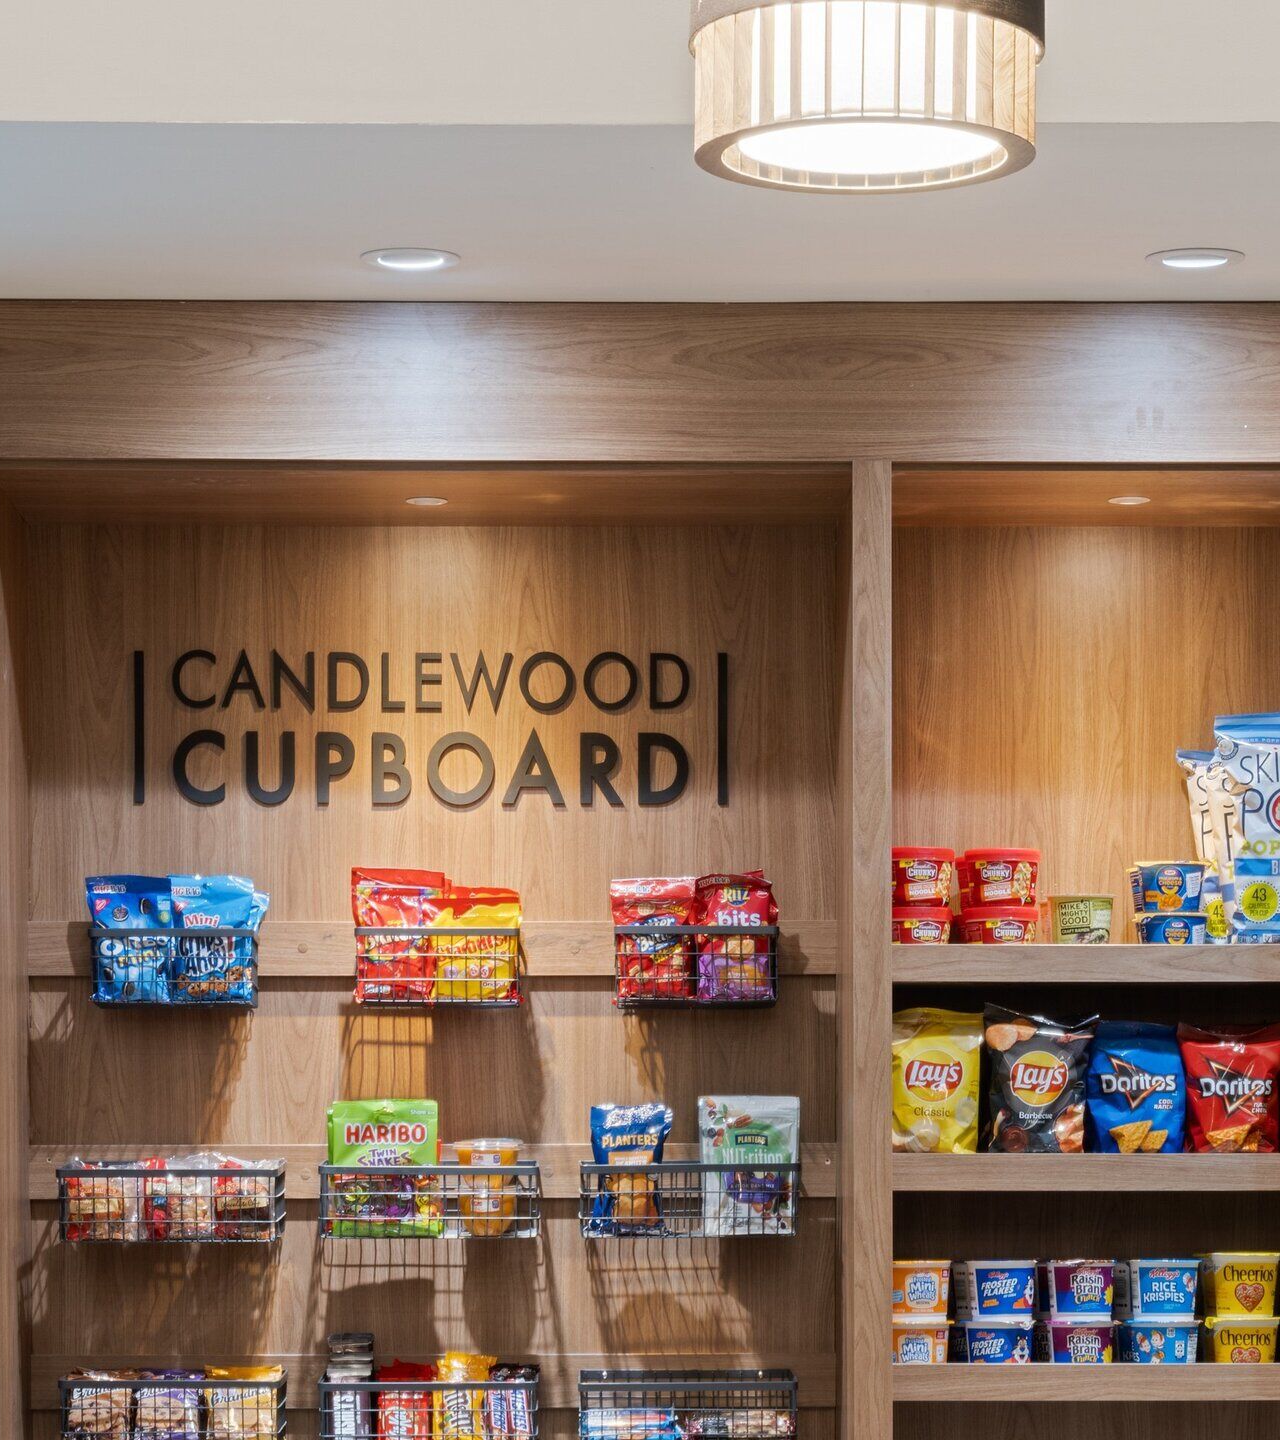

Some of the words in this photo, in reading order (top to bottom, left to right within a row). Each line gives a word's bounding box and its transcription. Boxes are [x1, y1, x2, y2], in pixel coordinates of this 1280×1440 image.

[171, 648, 692, 714] CANDLEWOOD
[171, 728, 692, 807] CUPBOARD
[908, 868, 936, 877] CHUNKY
[982, 869, 1010, 878] CHUNKY
[1251, 888, 1267, 902] 43
[1060, 902, 1089, 911] MIKE'S
[184, 913, 220, 927] Mini
[717, 910, 761, 926] bits
[1060, 910, 1089, 918] MIGHTY
[1061, 916, 1089, 926] GOOD
[913, 929, 940, 938] CHUNKY
[995, 929, 1022, 938] CHUNKY
[908, 1060, 961, 1094] Lay's
[1014, 1062, 1065, 1094] Lay's
[1100, 1072, 1177, 1094] Doritos
[1199, 1077, 1273, 1098] Doritos
[913, 1107, 951, 1118] Classic
[1018, 1110, 1053, 1120] Barbecue
[345, 1123, 426, 1144] HARIBO
[602, 1133, 659, 1148] PLANTERS
[368, 1149, 397, 1158] TWIN
[1223, 1264, 1274, 1283] Cheerios
[910, 1281, 936, 1291] Mini
[980, 1277, 1018, 1291] FROSTED
[1071, 1274, 1103, 1286] Raisin
[1151, 1281, 1177, 1291] RICE
[983, 1286, 1015, 1298] FLAKES
[1074, 1284, 1101, 1296] Bran
[1143, 1292, 1185, 1303] KRISPIES
[1068, 1335, 1100, 1347] Raisin
[1220, 1329, 1271, 1346] Cheerios
[902, 1342, 928, 1353] Mini
[971, 1338, 1005, 1350] FROSTED
[973, 1346, 1002, 1357] FLAKES
[1071, 1345, 1098, 1356] Bran
